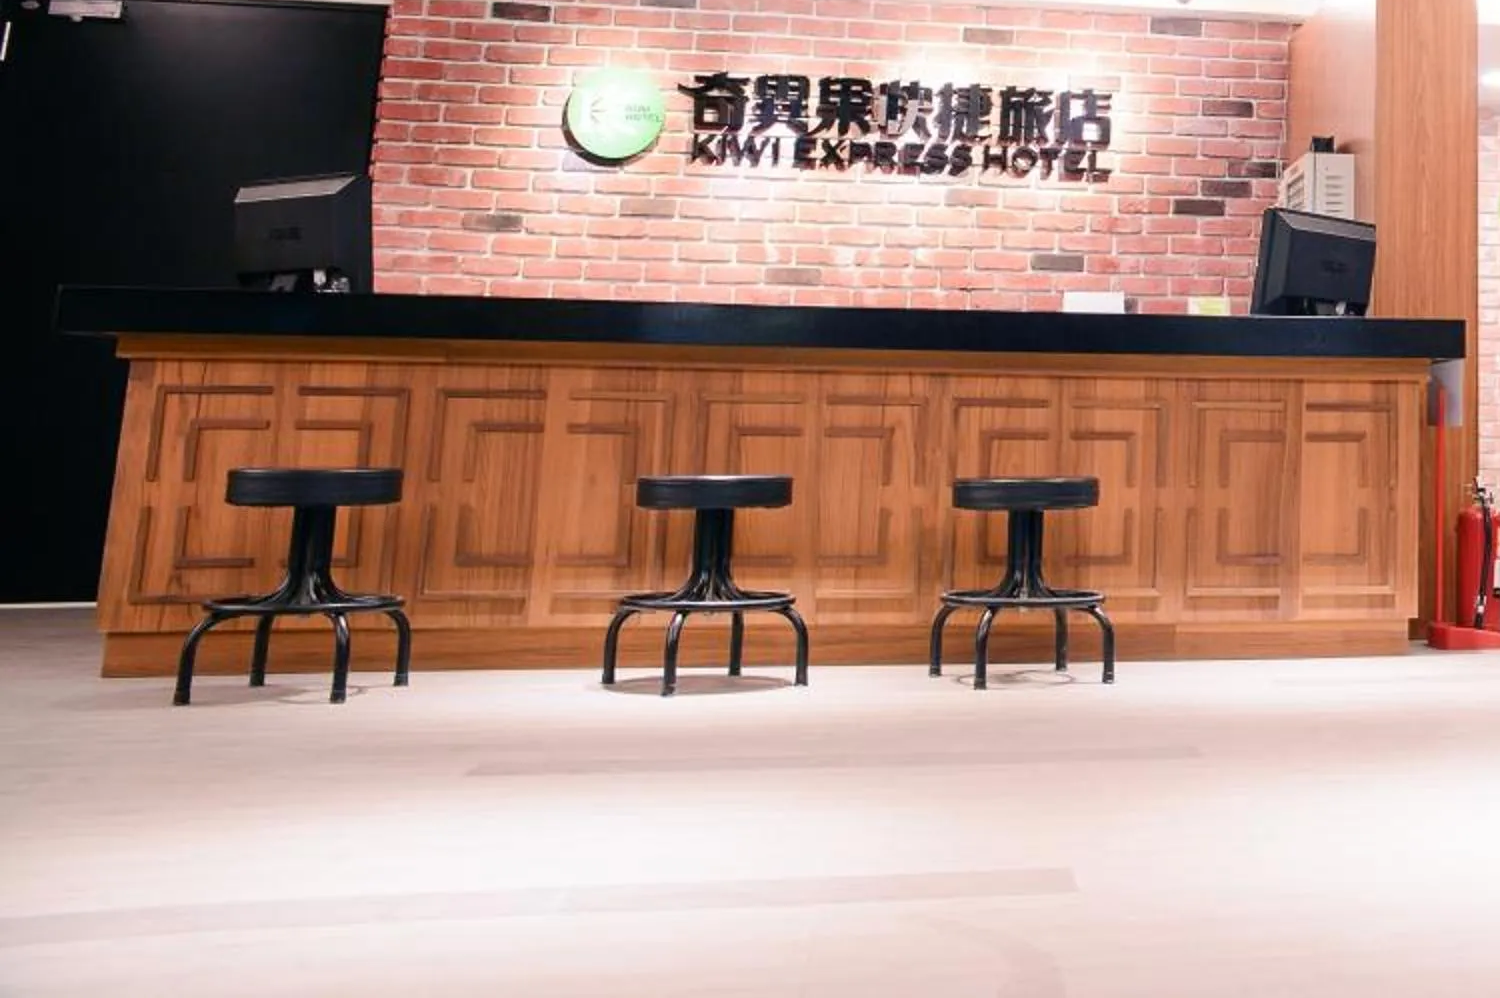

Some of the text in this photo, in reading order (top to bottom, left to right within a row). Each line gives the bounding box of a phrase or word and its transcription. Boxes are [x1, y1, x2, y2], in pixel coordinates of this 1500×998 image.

[678, 72, 1112, 147] 奇異果快捷旅店
[690, 133, 1112, 183] KIWI EXPRESS HOTEL
